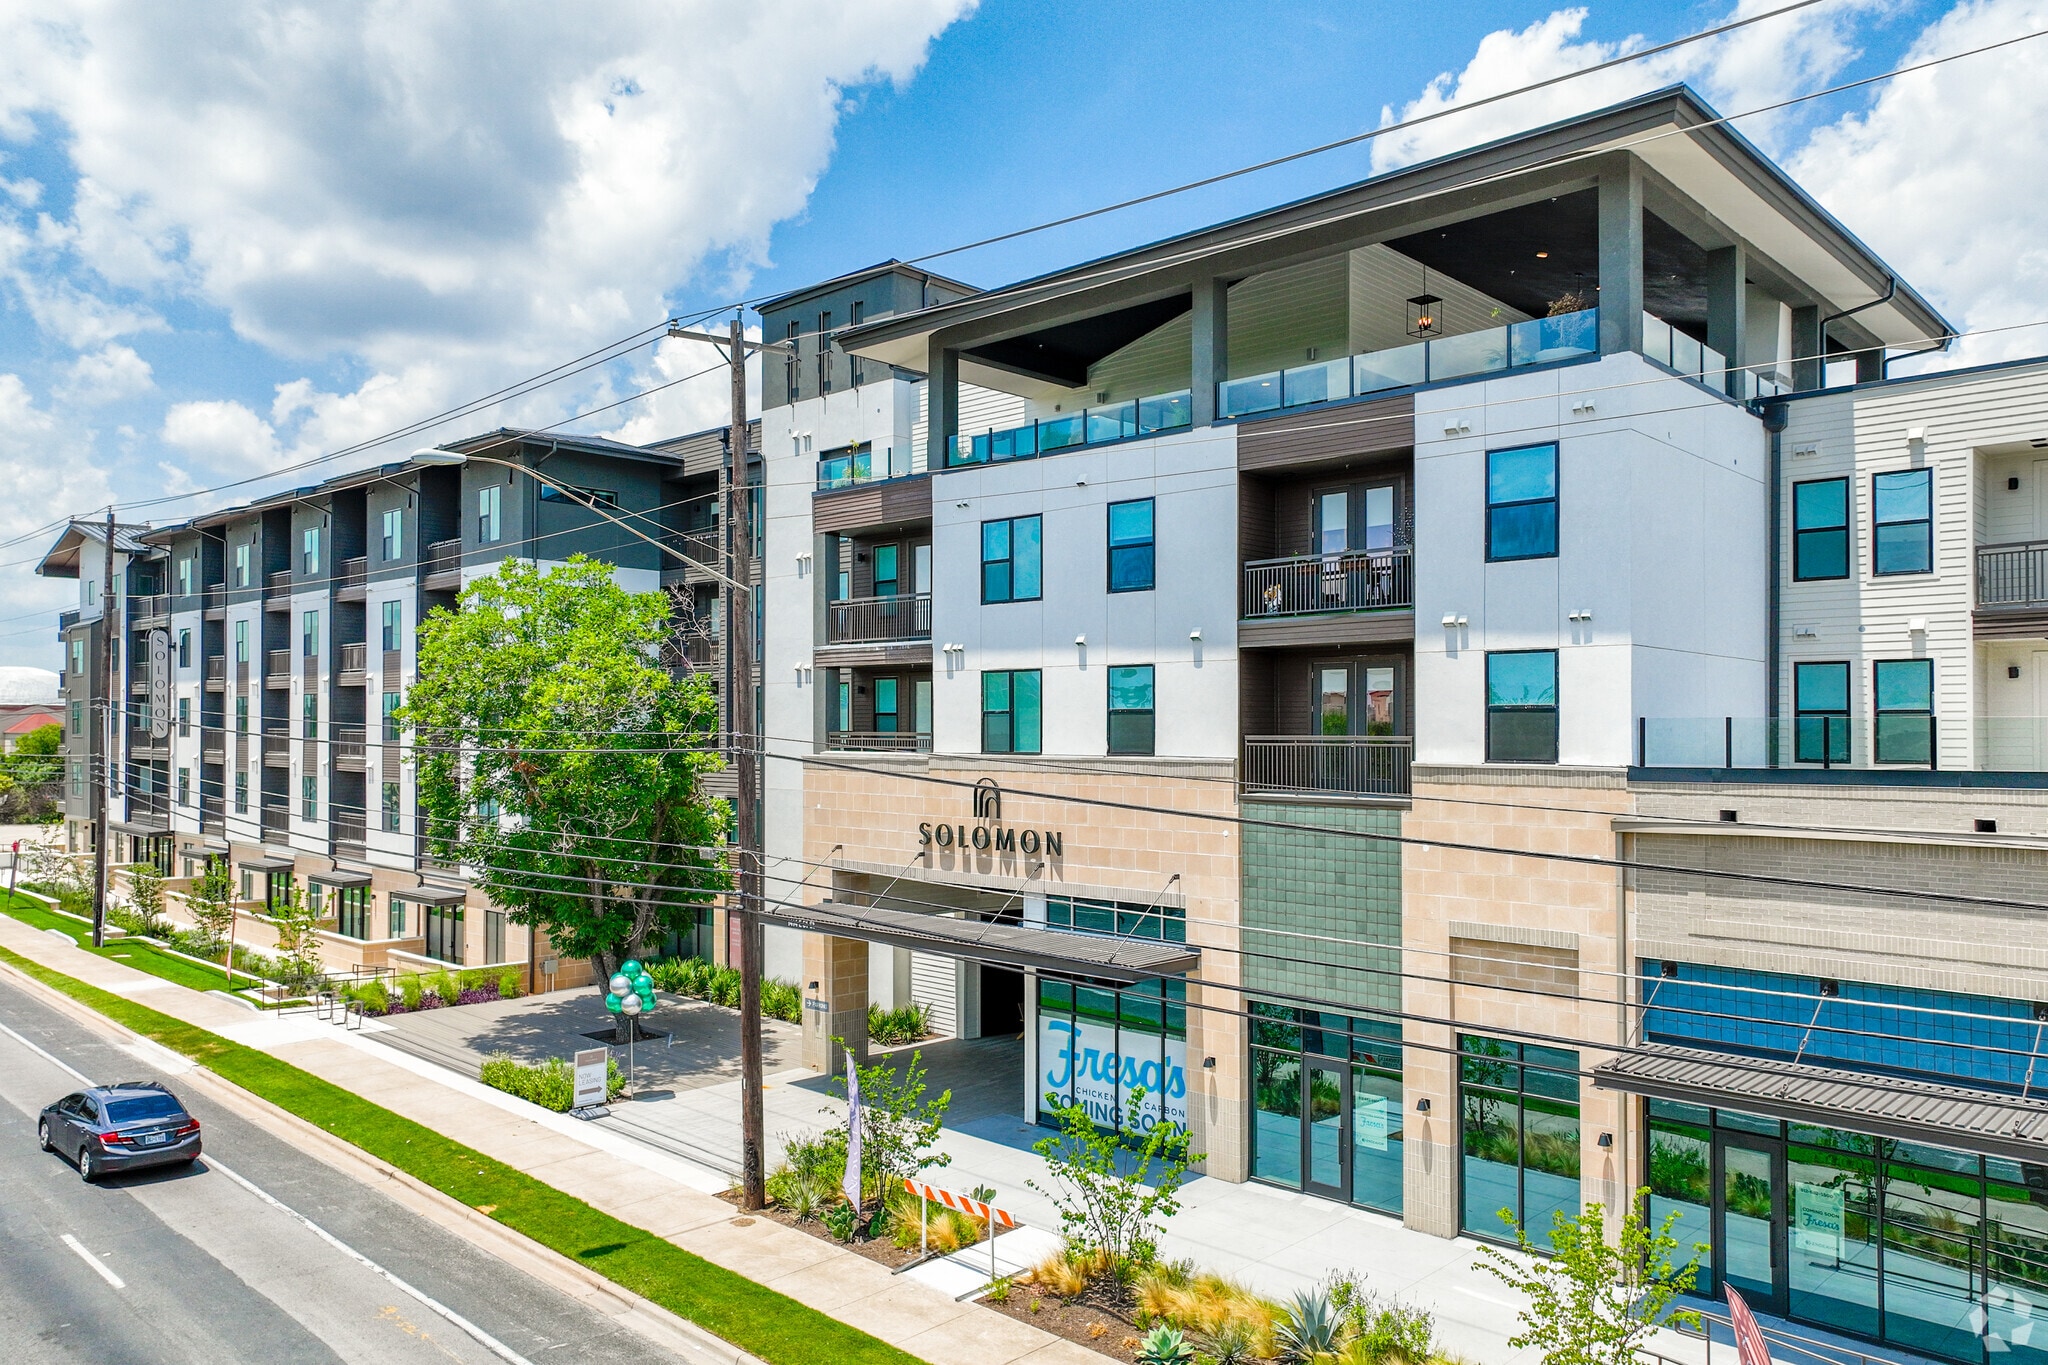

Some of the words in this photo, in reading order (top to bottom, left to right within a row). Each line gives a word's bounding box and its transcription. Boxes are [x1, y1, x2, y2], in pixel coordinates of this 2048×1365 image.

[154, 636, 166, 732] SOLOMON
[918, 822, 1062, 857] SOLOMON
[1046, 1020, 1186, 1099] Fresa's
[1076, 1086, 1115, 1102] CHICKEN
[1802, 1207, 1824, 1216] COMING
[1803, 1213, 1840, 1230] Fresa's
